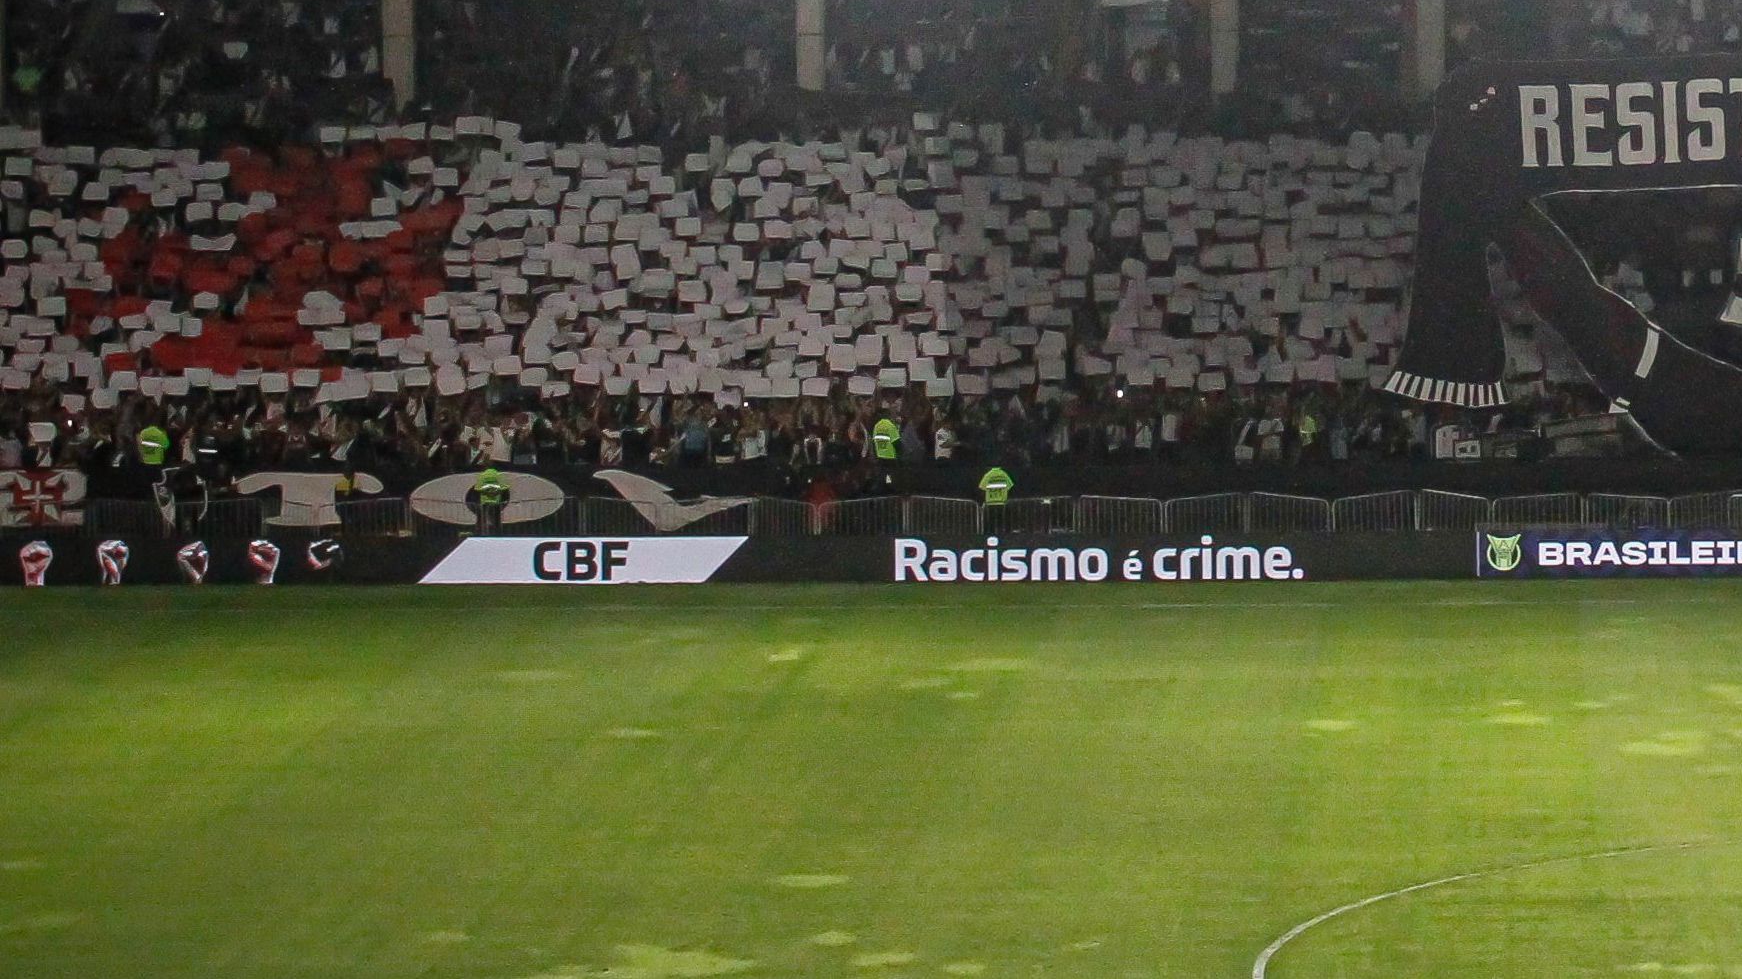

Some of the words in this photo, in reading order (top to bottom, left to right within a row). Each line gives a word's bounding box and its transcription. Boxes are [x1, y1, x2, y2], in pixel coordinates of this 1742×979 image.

[533, 541, 630, 581] CBF
[893, 536, 1109, 582] Racismo
[1122, 550, 1143, 580] é
[1153, 534, 1305, 581] crime.
